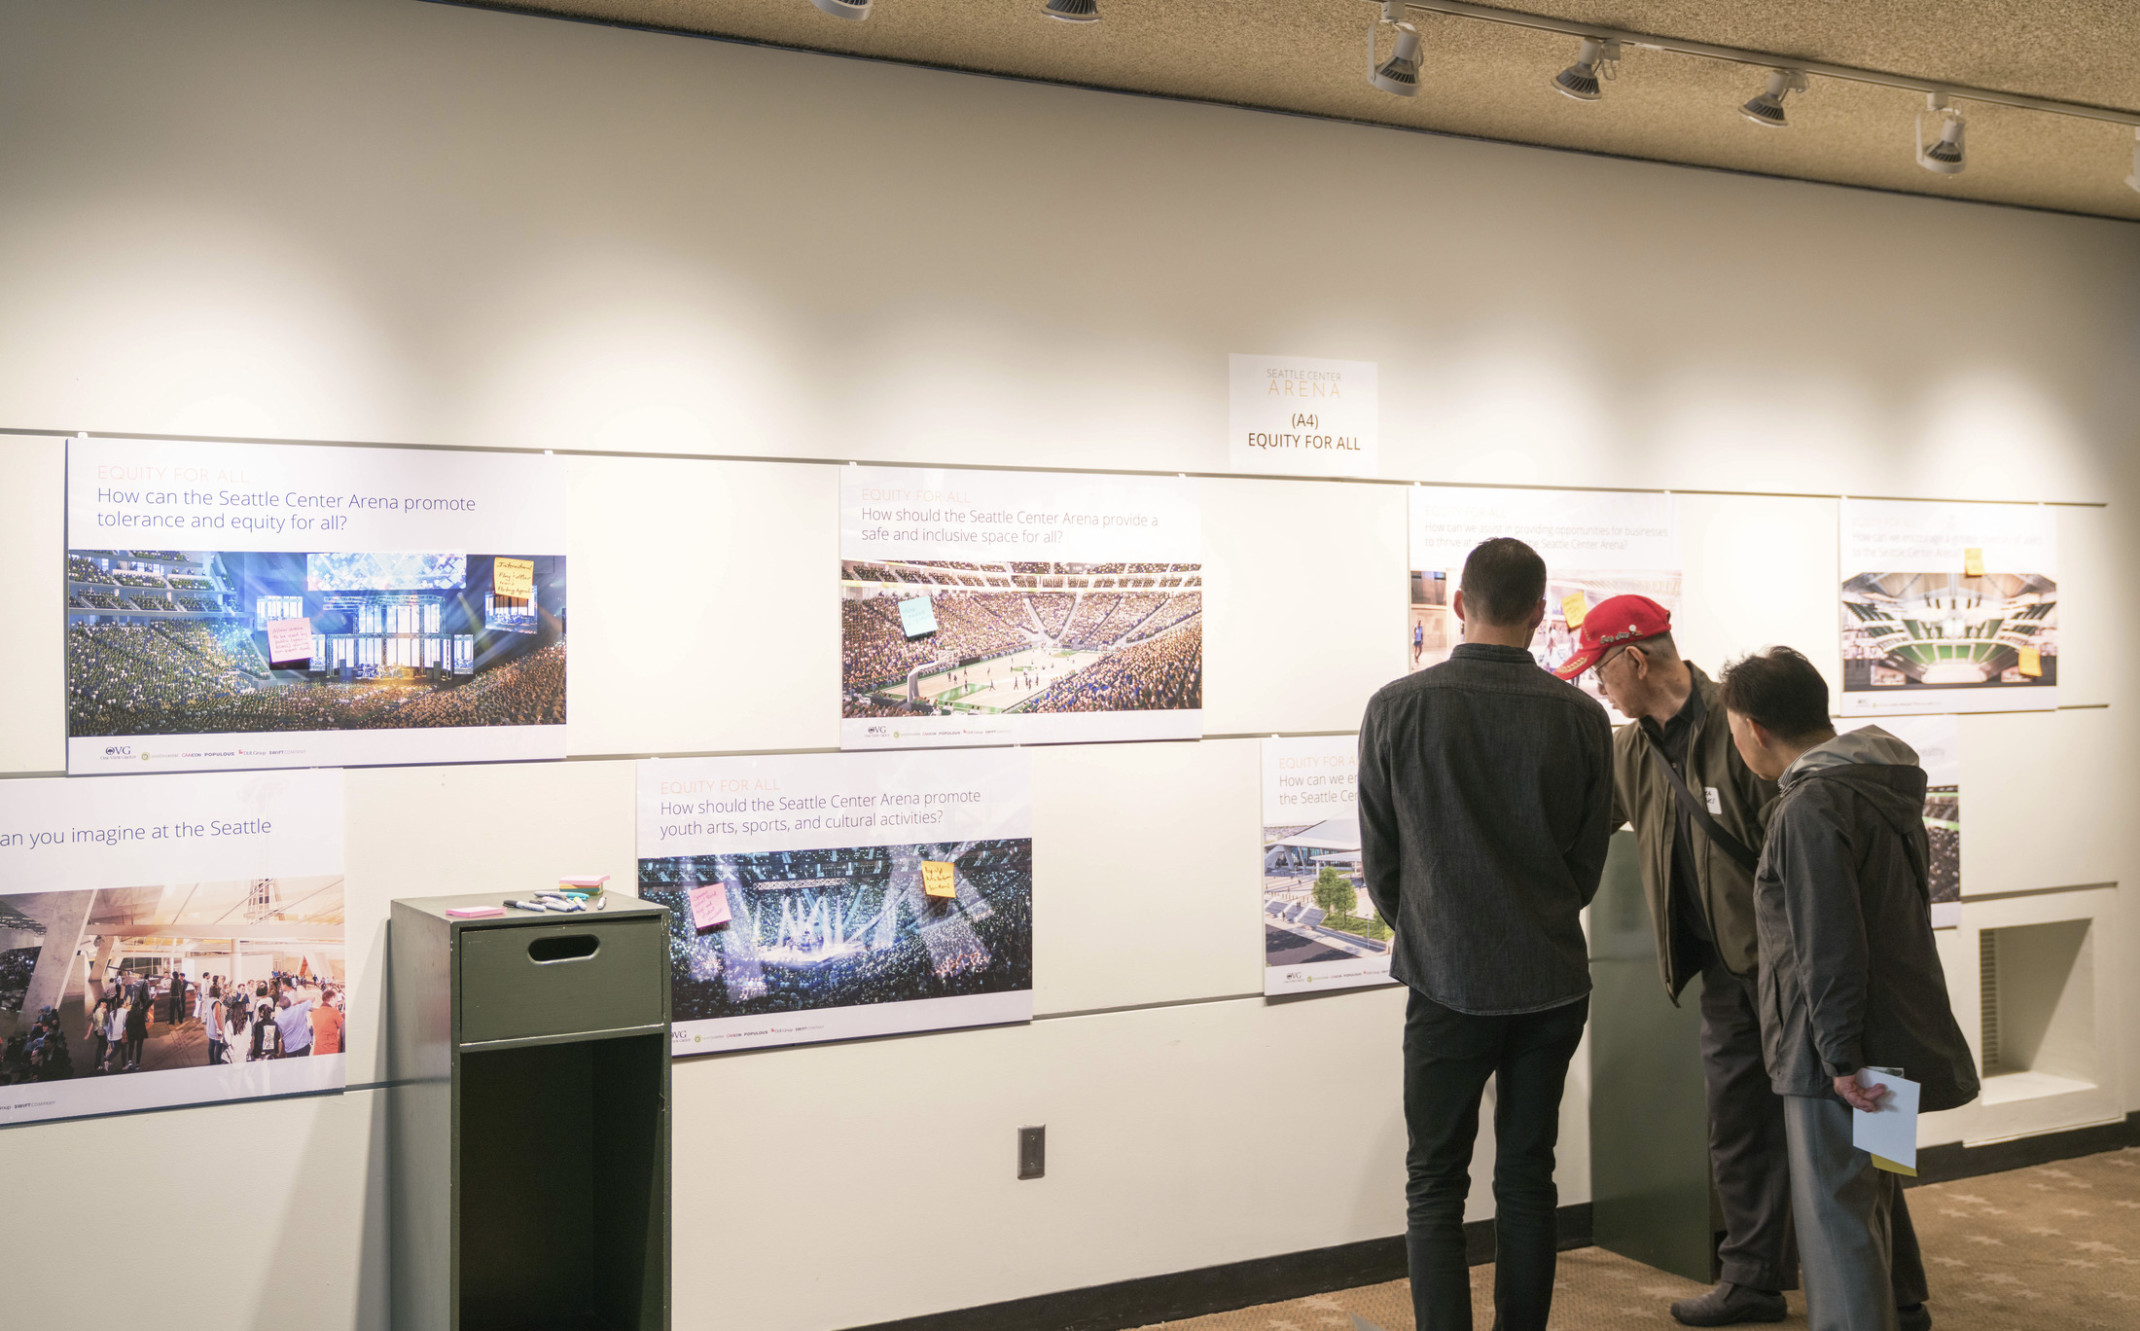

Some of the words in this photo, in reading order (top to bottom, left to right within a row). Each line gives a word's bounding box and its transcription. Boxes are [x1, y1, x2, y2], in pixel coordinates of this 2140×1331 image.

[1267, 368, 1305, 380] SEATTLE
[1307, 371, 1342, 381] CENTER
[1268, 379, 1341, 398] ARENA
[1292, 413, 1319, 430] (A4)
[1248, 432, 1301, 450] EQUITY
[1305, 435, 1333, 449] FOR
[1336, 436, 1361, 451] ALL
[97, 465, 166, 480] EQUITY
[174, 467, 208, 482] FOR
[217, 469, 250, 483] ALL
[98, 488, 140, 503] How
[145, 491, 177, 505] can
[184, 489, 213, 505] the
[219, 490, 280, 507] Seattle
[285, 491, 343, 508] Center
[349, 494, 398, 510] Arena
[404, 497, 476, 514] promote
[862, 488, 911, 501] EQUITY
[916, 490, 942, 502] FOR
[947, 491, 972, 503] ALL
[98, 511, 185, 528] tolerance
[191, 513, 225, 528] and
[231, 514, 286, 534] equity
[291, 514, 315, 530] for
[320, 515, 348, 531] all?
[862, 508, 892, 521] How
[896, 508, 941, 522] should
[945, 509, 966, 523] the
[969, 510, 1013, 524] Seattle
[1017, 511, 1059, 525] Center
[1062, 512, 1099, 525] Arena
[1103, 514, 1148, 528] provide
[1152, 517, 1159, 526] a
[862, 527, 889, 541] safe
[893, 528, 918, 541] and
[922, 528, 978, 542] inclusive
[981, 532, 1018, 545] space
[1022, 529, 1039, 542] for
[1043, 530, 1063, 543] all?
[1425, 520, 1445, 532] How
[1446, 523, 1462, 532] can
[1465, 524, 1477, 533] we
[1505, 523, 1513, 534] in
[1514, 524, 1553, 537] providing
[1555, 525, 1609, 538] opportunities
[1611, 525, 1622, 536] for
[1624, 526, 1668, 537] businesses
[1425, 537, 1433, 547] to
[1541, 539, 1569, 549] Seattle
[1571, 539, 1599, 549] Center
[1600, 539, 1629, 550] Arena?
[1279, 757, 1319, 769] EQUITY
[1323, 756, 1344, 767] FOR
[660, 780, 715, 795] EQUITY
[720, 779, 749, 792] FOR
[754, 778, 781, 791] ALL
[1280, 775, 1304, 787] How
[1307, 775, 1326, 786] can
[1329, 774, 1344, 784] we
[661, 801, 694, 815] How
[698, 798, 747, 814] should
[751, 798, 775, 812] the
[779, 795, 827, 811] Seattle
[830, 794, 877, 808] Center
[880, 793, 920, 806] Arena
[924, 790, 981, 808] promote
[1280, 792, 1297, 805] the
[1301, 790, 1337, 804] Seattle
[30, 831, 64, 850] you
[72, 825, 146, 846] imagine
[152, 824, 169, 839] at
[175, 822, 205, 838] the
[210, 818, 272, 837] Seattle
[659, 820, 702, 841] youth
[707, 821, 738, 835] arts,
[742, 819, 790, 836] sports,
[795, 815, 821, 830] and
[825, 812, 876, 828] cultural
[880, 809, 944, 826] activities?
